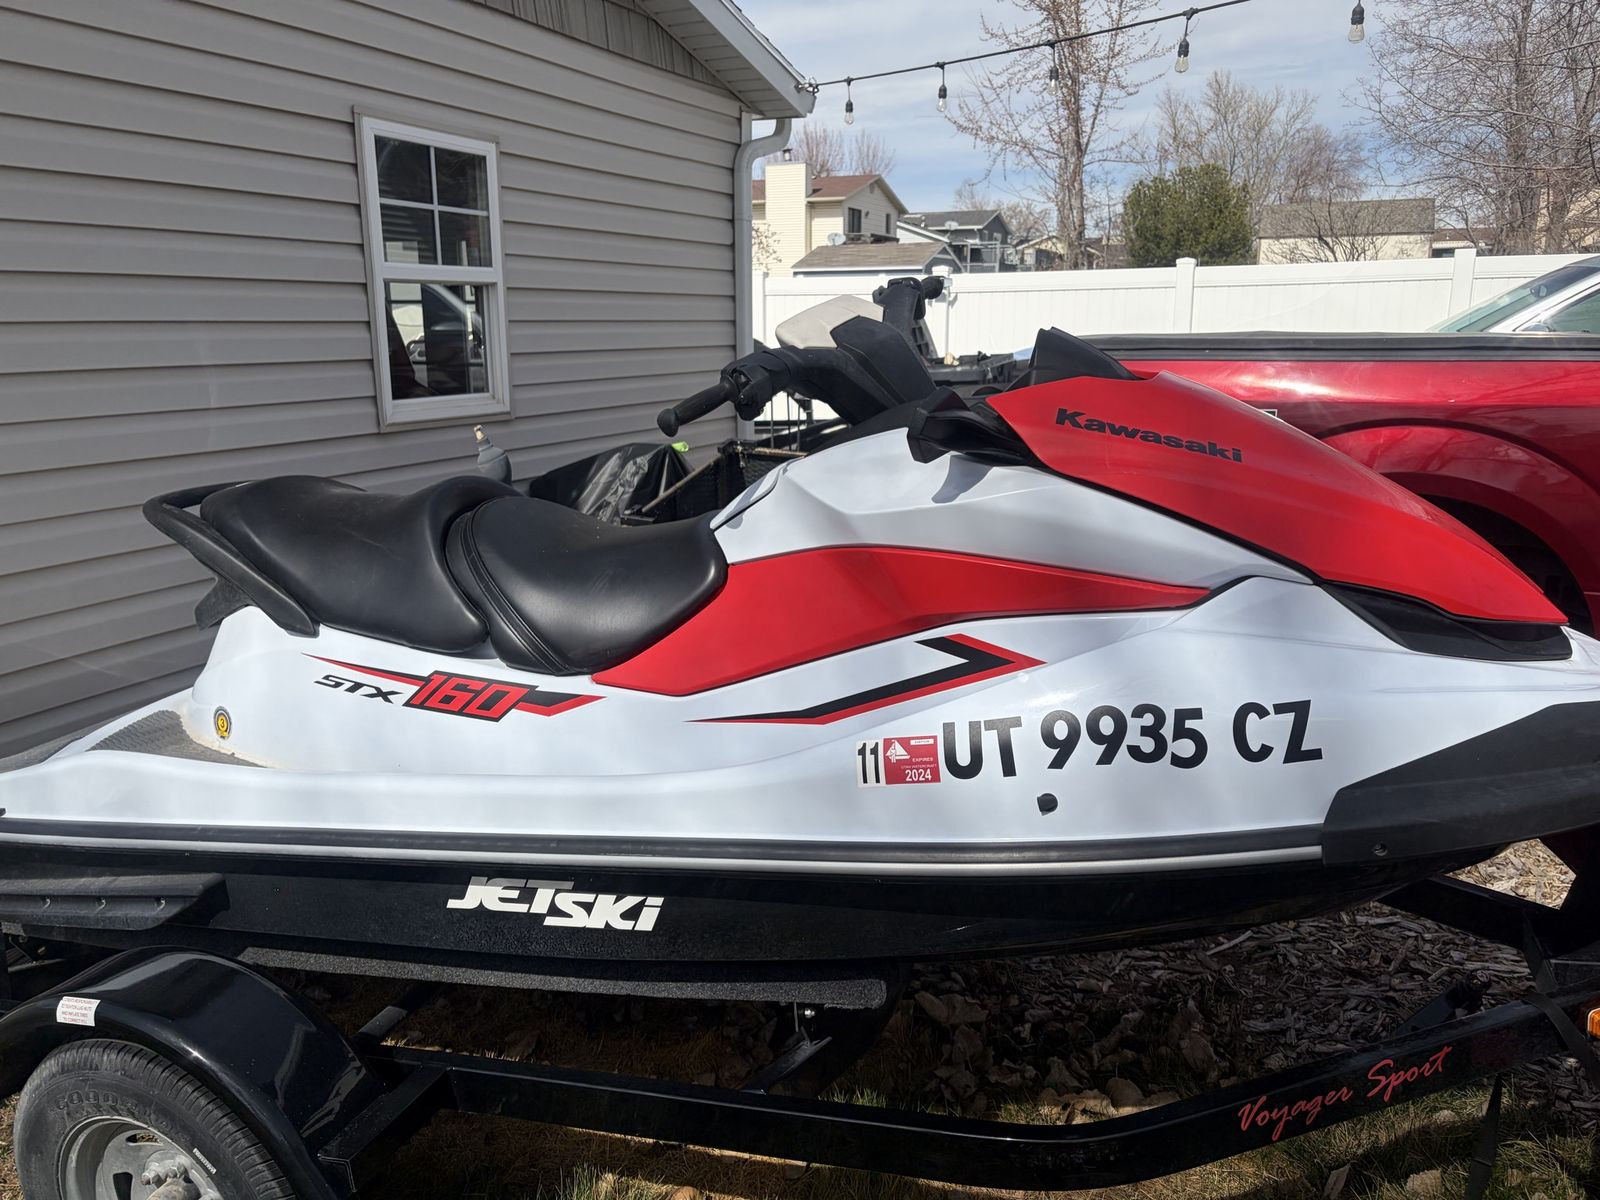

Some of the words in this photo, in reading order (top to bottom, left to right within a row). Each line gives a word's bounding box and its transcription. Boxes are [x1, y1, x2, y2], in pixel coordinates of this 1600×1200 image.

[1055, 407, 1243, 463] Kawasaki
[313, 674, 403, 704] STX
[409, 673, 530, 719] 160
[857, 741, 881, 784] 11
[942, 716, 1023, 780] UT
[1040, 703, 1208, 770] 9935
[1232, 699, 1323, 765] CZ
[905, 768, 932, 782] 2024
[1237, 1086, 1353, 1141] Voyager
[1366, 1046, 1453, 1101] Sport
